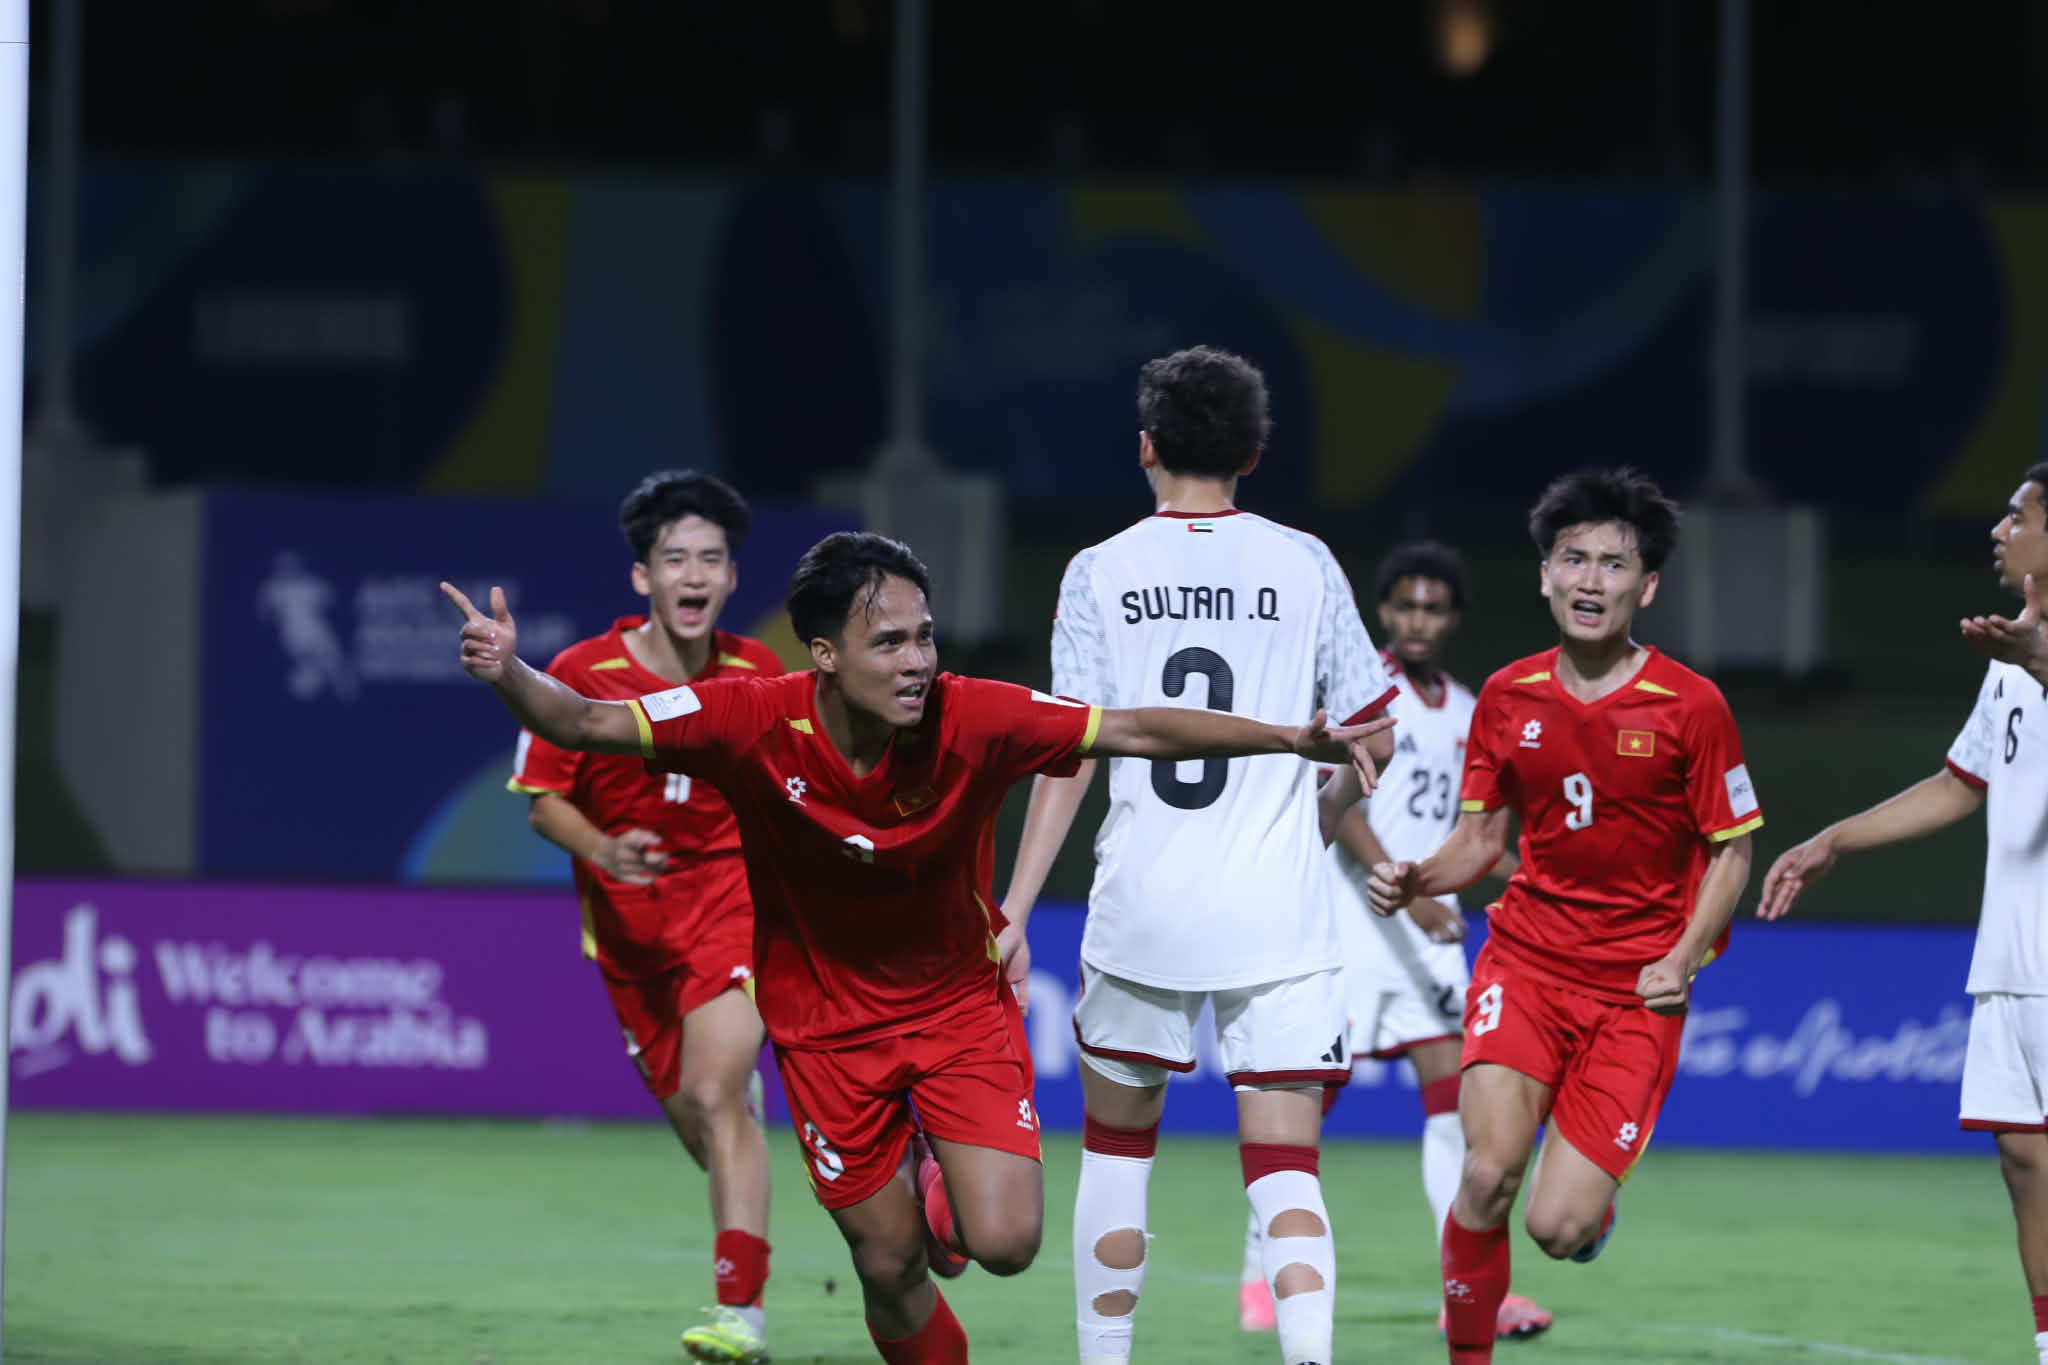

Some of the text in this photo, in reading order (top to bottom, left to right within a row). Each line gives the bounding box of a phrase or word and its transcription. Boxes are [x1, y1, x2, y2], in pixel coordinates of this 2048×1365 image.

[1121, 586, 1235, 624] SULTAN
[1408, 769, 1451, 820] 23
[1563, 772, 1593, 831] 9
[155, 939, 443, 1005] Welcome
[206, 1006, 488, 1068] to Arabia
[1472, 983, 1504, 1036] 9
[803, 1121, 845, 1182] 3
